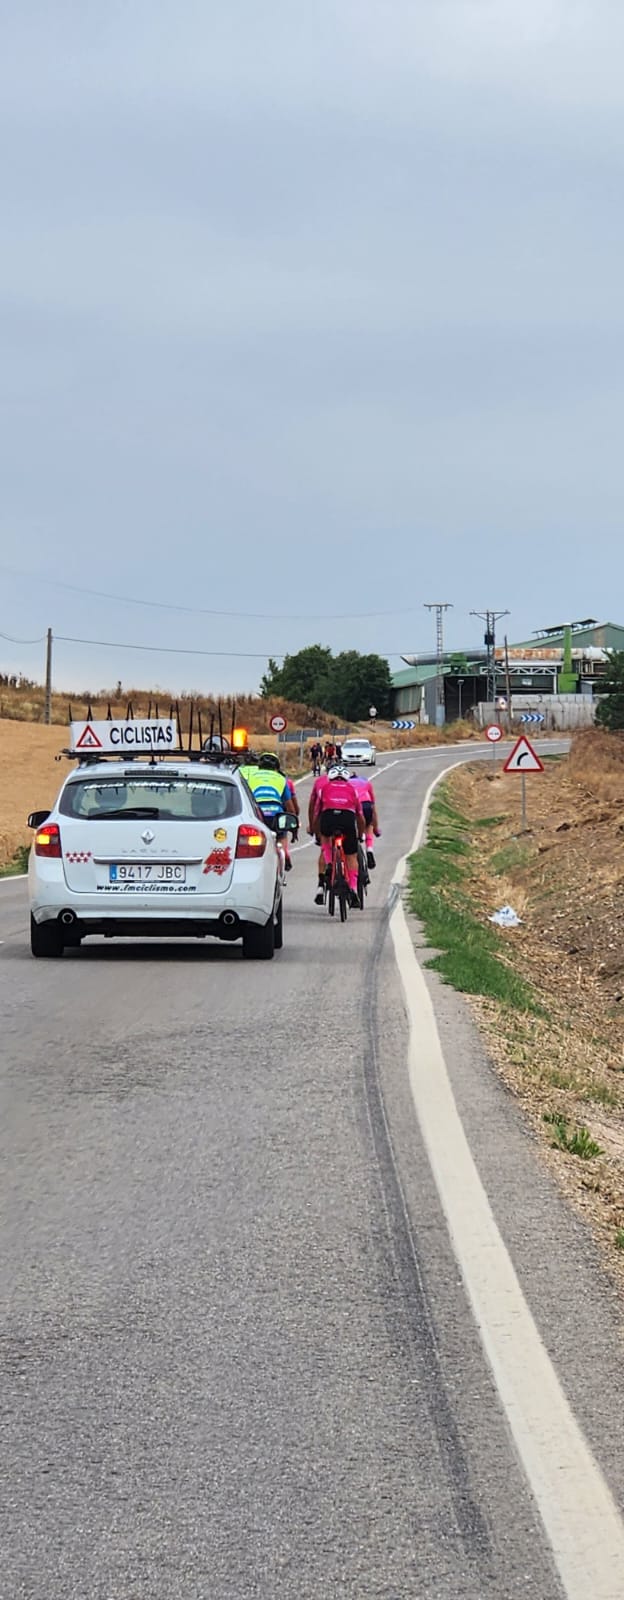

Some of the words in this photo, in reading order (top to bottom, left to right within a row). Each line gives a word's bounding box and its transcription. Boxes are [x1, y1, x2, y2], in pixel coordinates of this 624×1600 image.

[109, 726, 173, 745] CICLISTAS
[119, 866, 152, 879] 9417
[157, 866, 182, 879] JBC
[96, 883, 197, 892] www.fmciclismo.com
